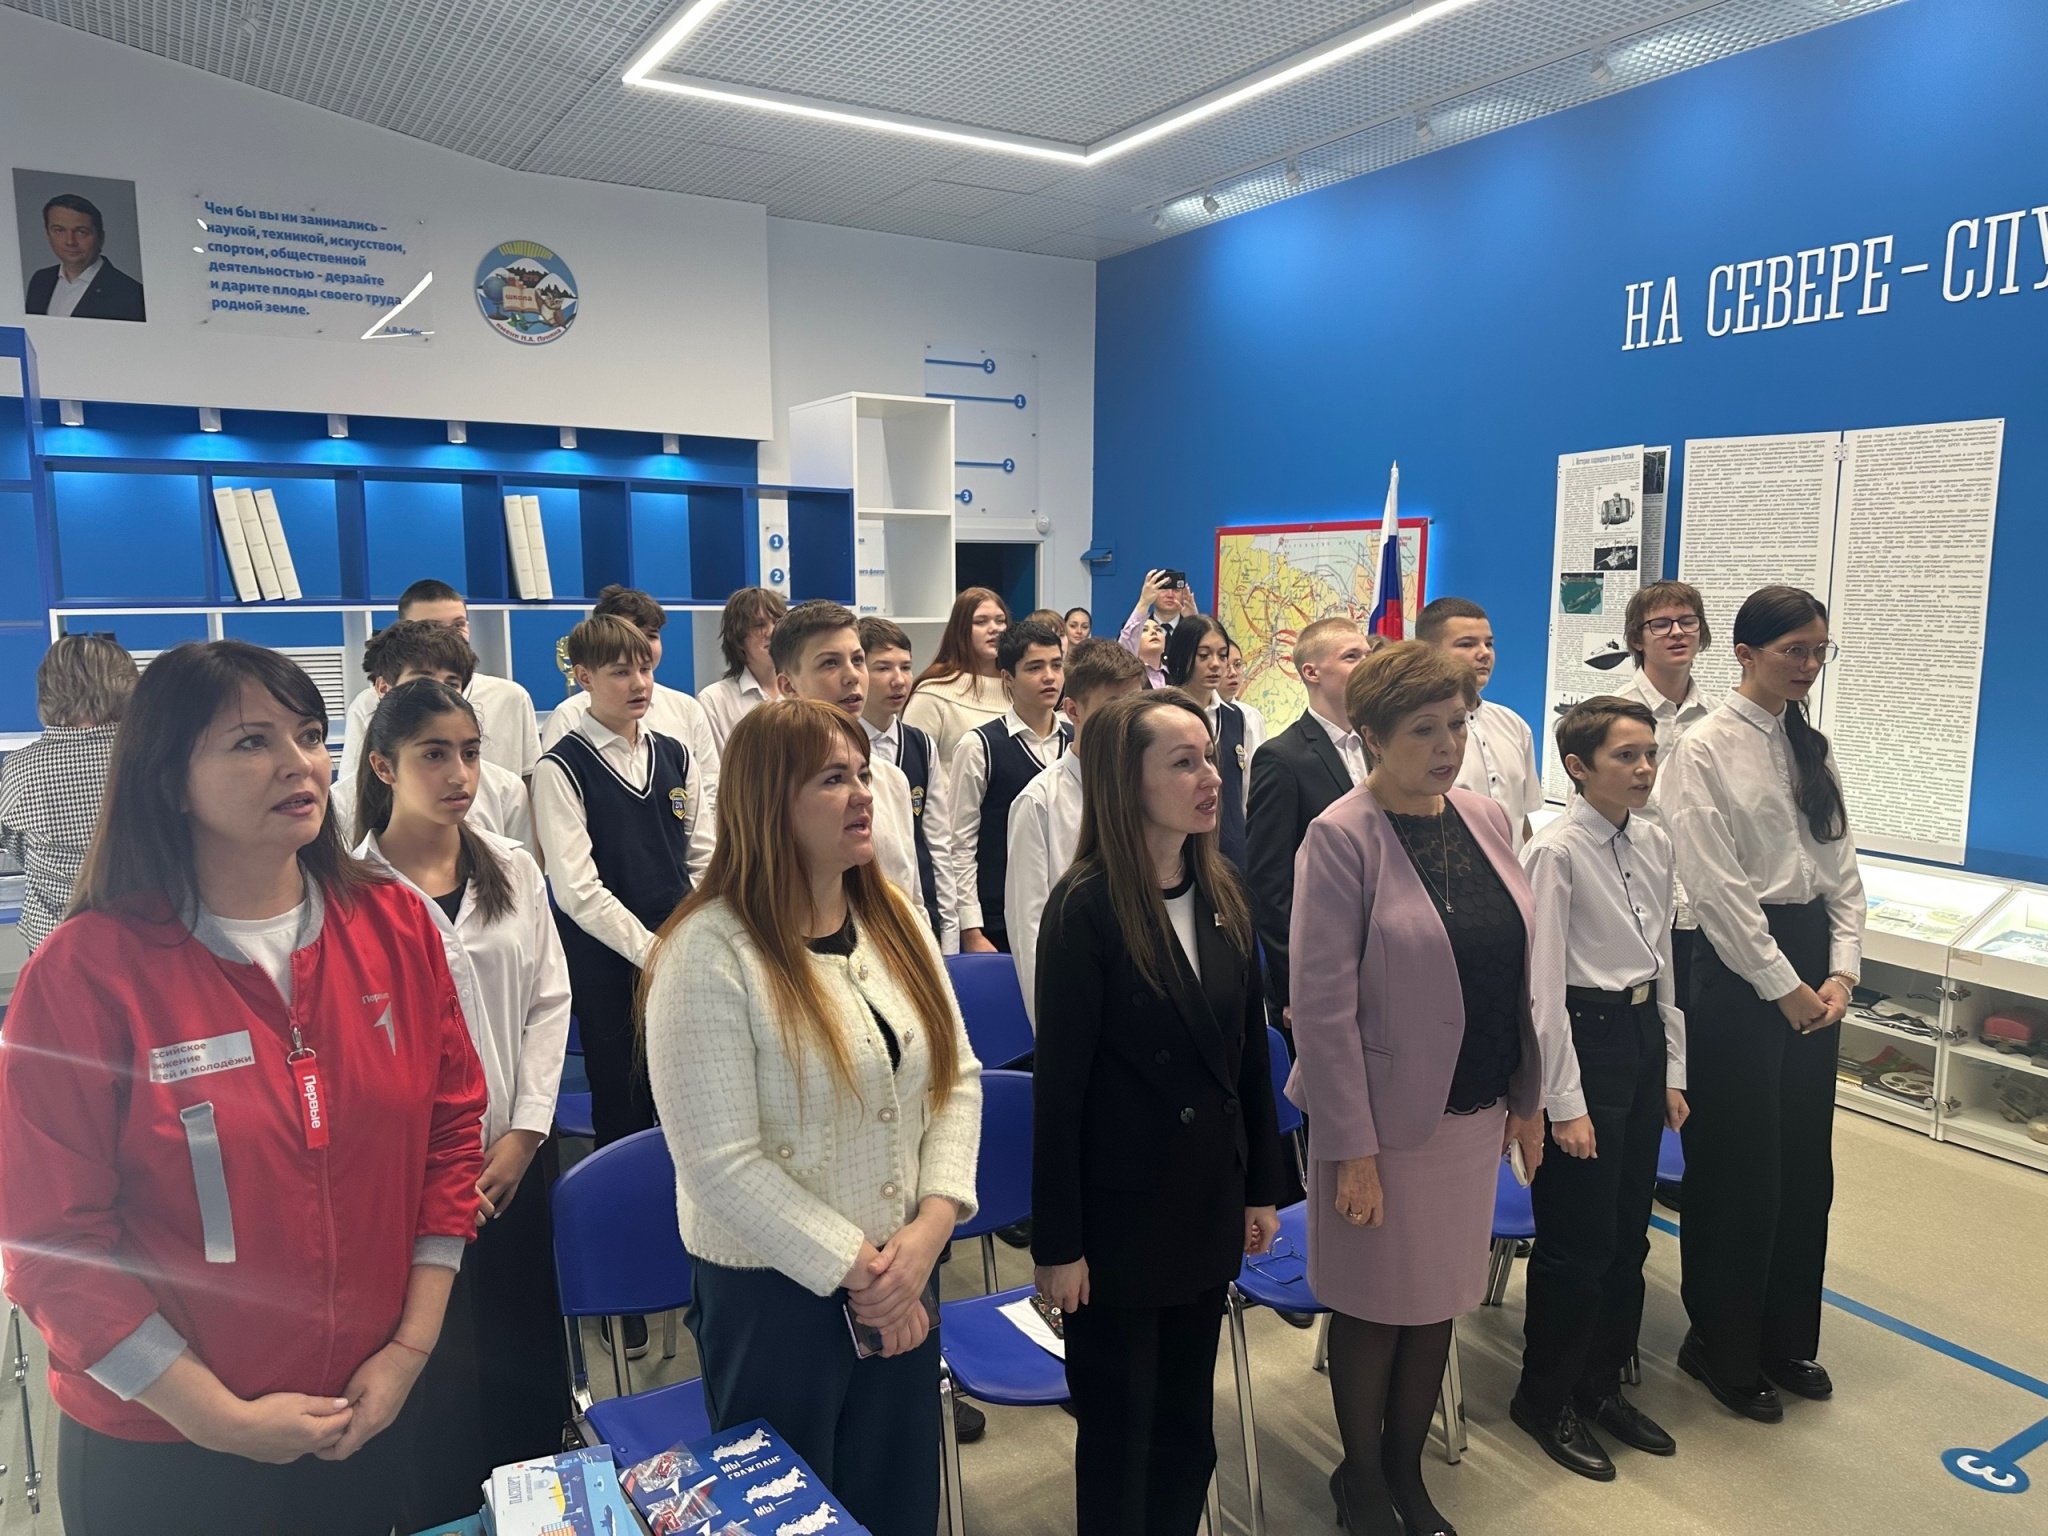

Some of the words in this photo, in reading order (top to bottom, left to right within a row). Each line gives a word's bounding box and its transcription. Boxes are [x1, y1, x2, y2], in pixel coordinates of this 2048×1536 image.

[205, 201, 233, 216] Чем
[236, 206, 256, 219] бы
[259, 211, 279, 222] вы
[281, 213, 297, 223] ни
[300, 214, 378, 232] занимались
[207, 223, 261, 241] наукой,
[261, 229, 328, 247] техникой,
[330, 236, 406, 255] искусством,
[208, 241, 269, 259] спортом,
[270, 248, 366, 267] общественной
[209, 261, 315, 280] деятельностью
[325, 272, 385, 289] дерзайте
[210, 279, 220, 289] и
[221, 281, 270, 296] дарите
[272, 285, 318, 299] плоды
[320, 289, 363, 302] своего
[365, 293, 402, 307] труда
[211, 298, 263, 312] родной
[265, 302, 310, 315] земле.
[1621, 276, 1683, 351] НА
[985, 361, 994, 371] 5
[1017, 397, 1023, 406] 1
[1005, 461, 1012, 470] 2
[962, 492, 970, 501] 3
[773, 537, 780, 547] 1
[774, 571, 781, 581] 2
[303, 1074, 321, 1129] Первые
[720, 1460, 741, 1473] МЫ
[1957, 1455, 2016, 1487] 3
[753, 1503, 776, 1517] МЫ
